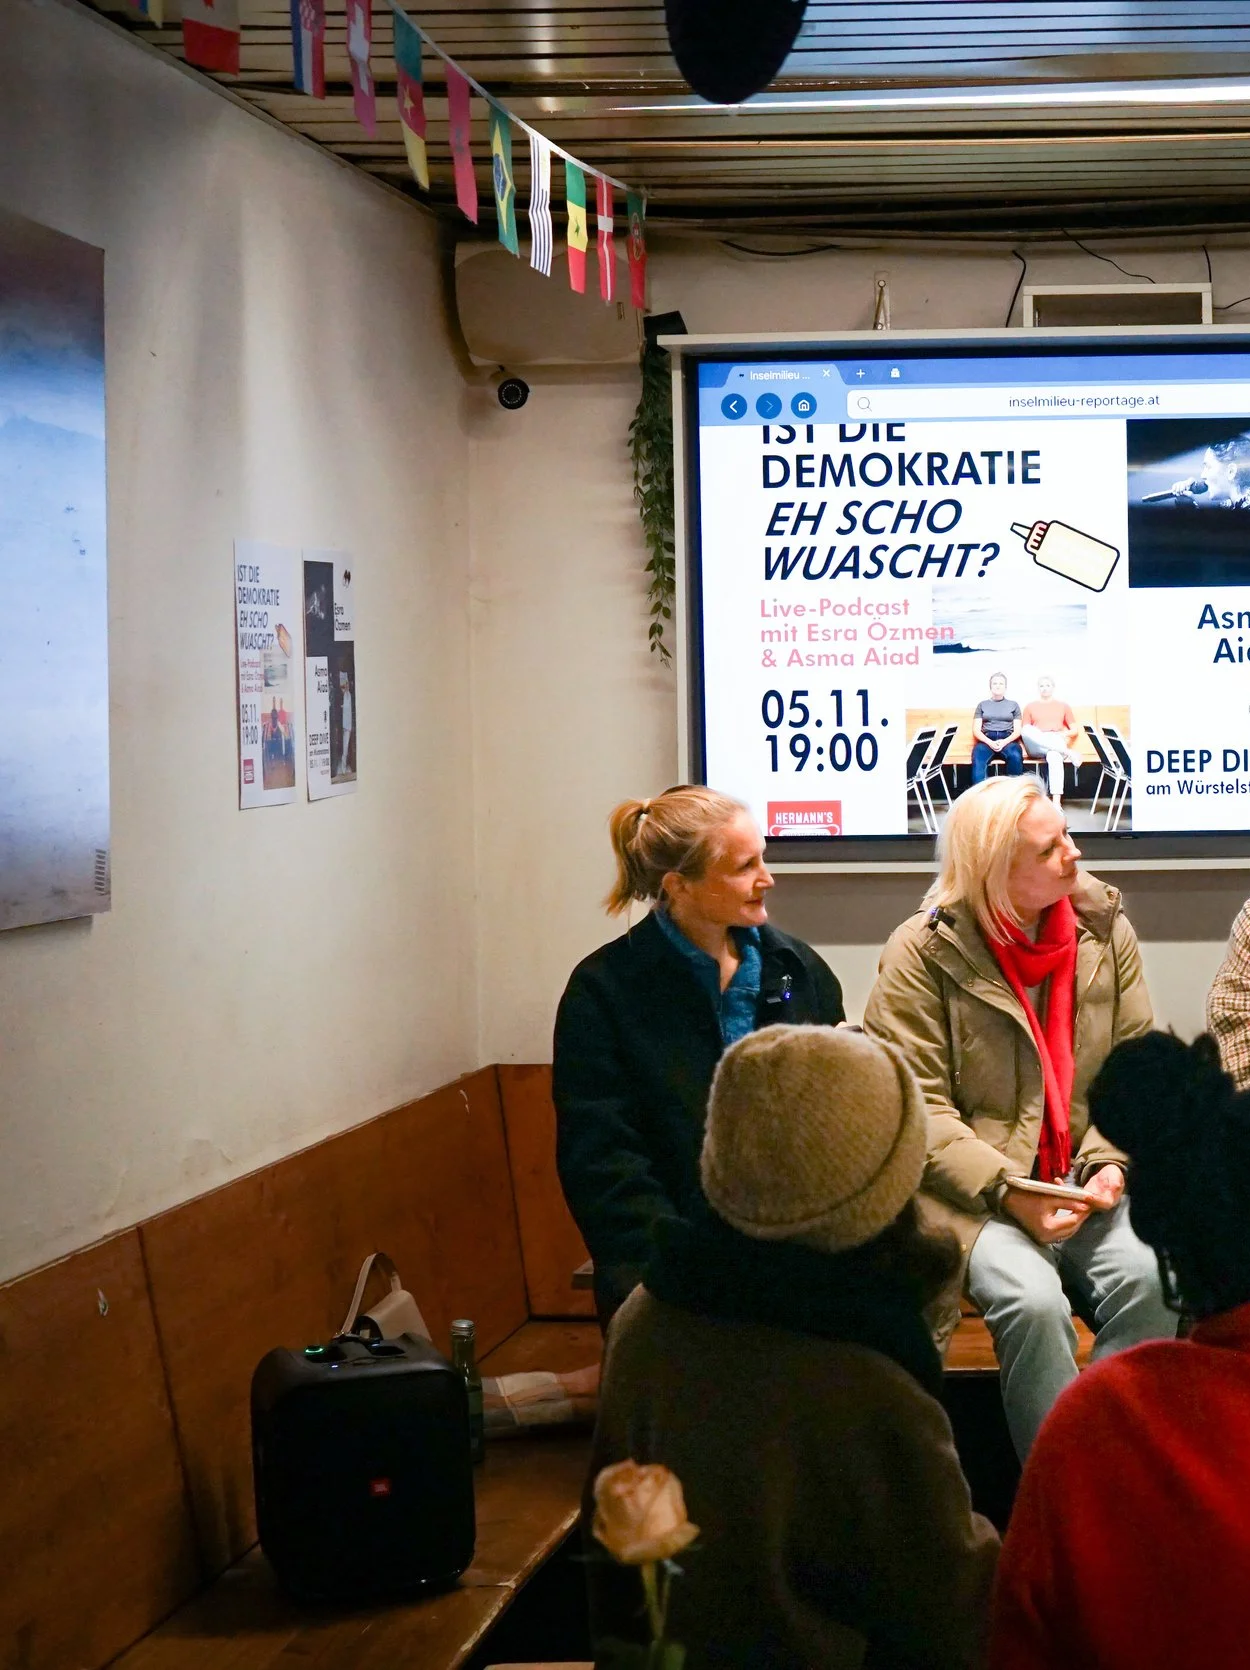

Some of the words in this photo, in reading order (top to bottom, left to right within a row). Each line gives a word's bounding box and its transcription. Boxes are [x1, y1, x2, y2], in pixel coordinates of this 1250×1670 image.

[749, 369, 800, 382] Inselmilieu
[1009, 394, 1160, 409] inselmilieu-reportage.at
[762, 450, 1041, 489] DEMOKRATIE
[765, 501, 828, 537] EH
[835, 498, 963, 536] SCHO
[764, 542, 1001, 581] WUASCHT?
[237, 565, 247, 582] IST
[249, 566, 260, 583] DIE
[238, 586, 280, 606] DEMOKRATIE
[760, 597, 909, 618] Live-Podcast
[249, 610, 269, 629] SCHO
[761, 623, 797, 643] mit
[807, 623, 857, 641] Esra
[867, 617, 956, 641] Özmen
[761, 648, 777, 667] &
[787, 649, 854, 667] Asma
[864, 646, 919, 666] Aiad
[761, 689, 889, 729] 05.11.
[765, 732, 879, 773] 19:00
[1147, 750, 1212, 774] DEEP
[1145, 783, 1165, 796] am
[775, 811, 834, 825] HERMANN'S
